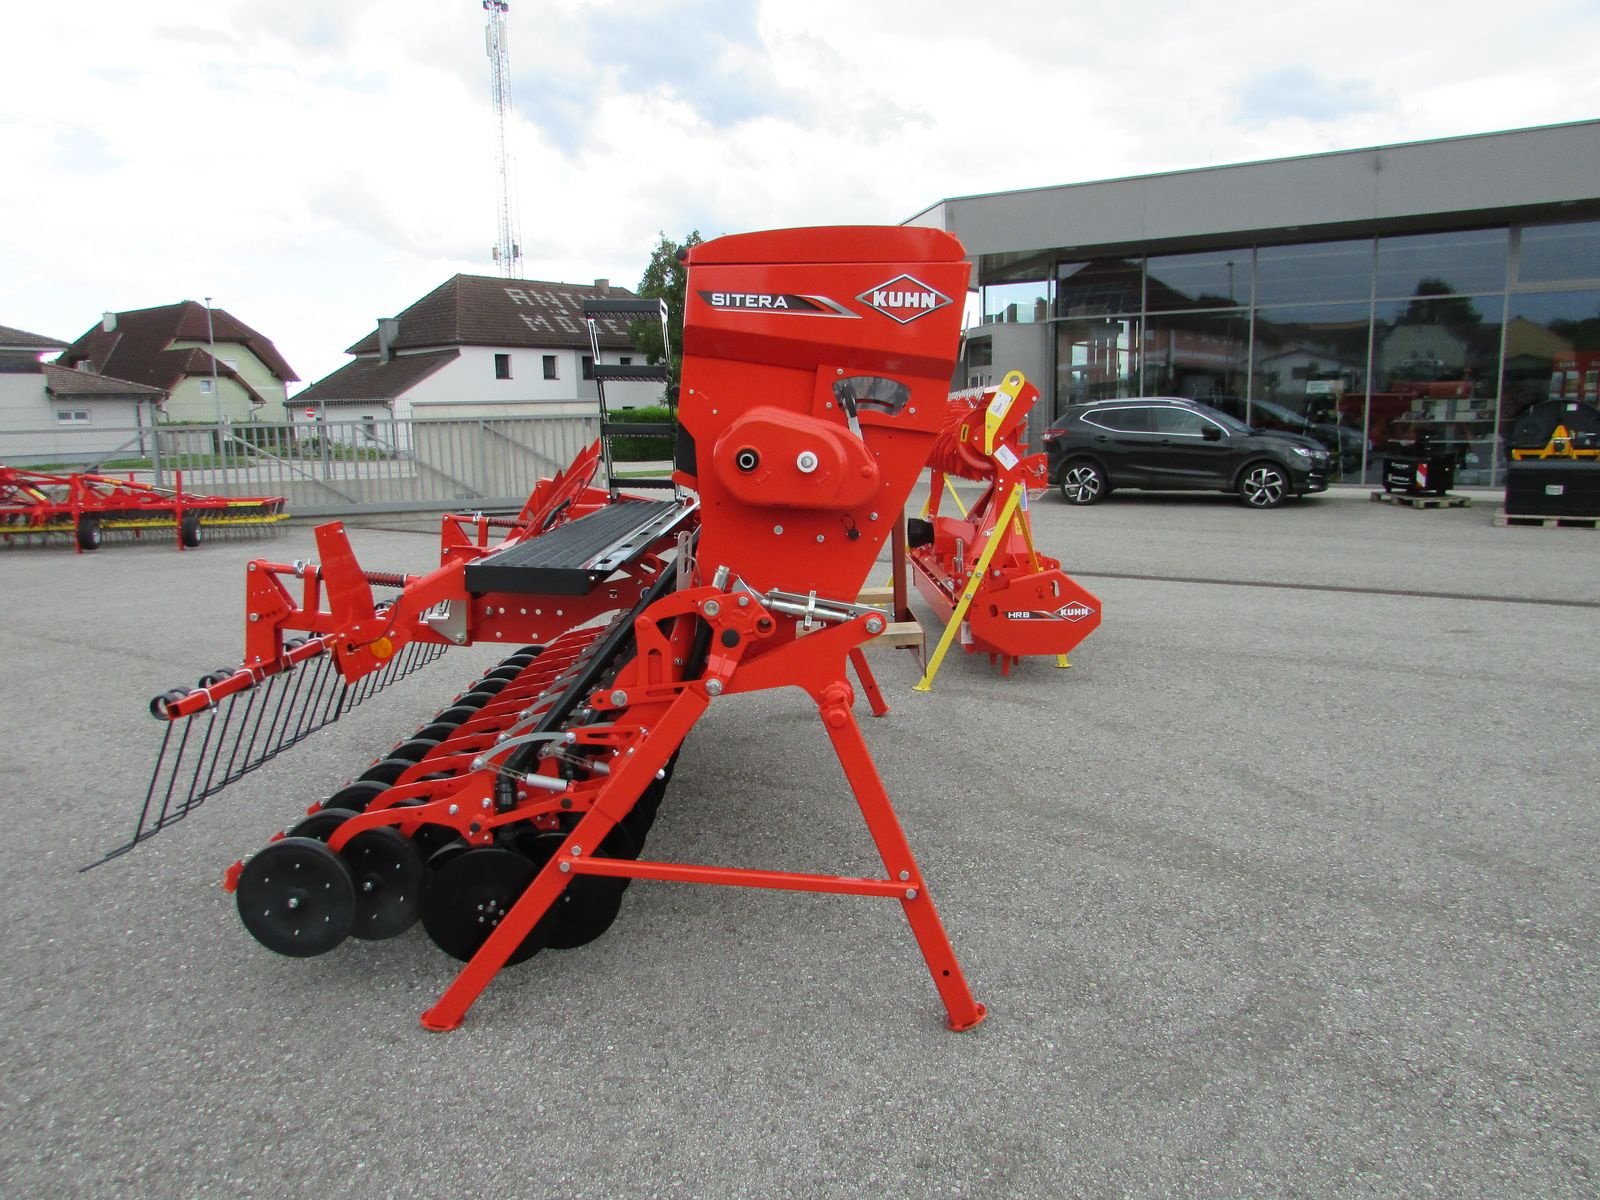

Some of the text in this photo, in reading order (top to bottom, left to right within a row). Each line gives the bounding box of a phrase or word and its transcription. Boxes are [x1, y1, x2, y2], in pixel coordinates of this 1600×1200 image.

[504, 288, 607, 309] ANT
[711, 293, 788, 309] SITERA
[872, 290, 936, 308] KUHN
[1007, 611, 1030, 619] HRB
[1060, 608, 1089, 616] KUHN
